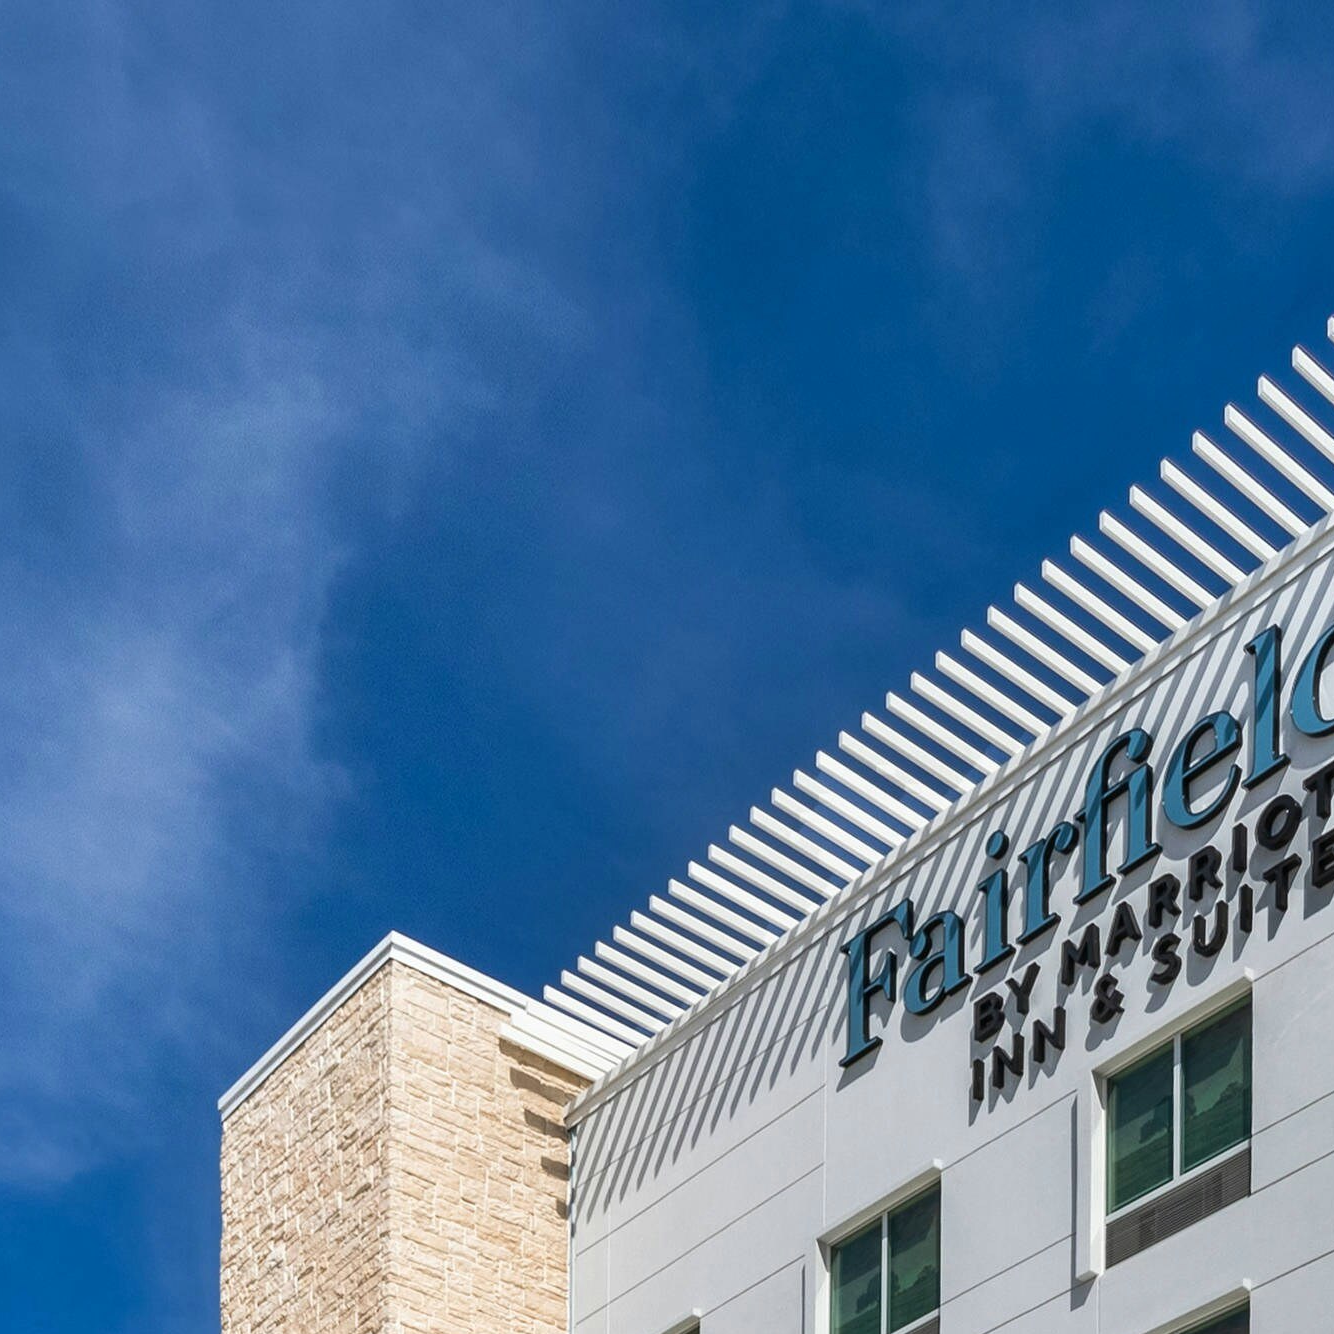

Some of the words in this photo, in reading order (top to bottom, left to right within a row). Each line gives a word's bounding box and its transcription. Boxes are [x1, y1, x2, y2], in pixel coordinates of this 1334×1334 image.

[971, 1006, 1066, 1102] INN
[1091, 973, 1125, 1025] &
[973, 963, 1040, 1044] BY
